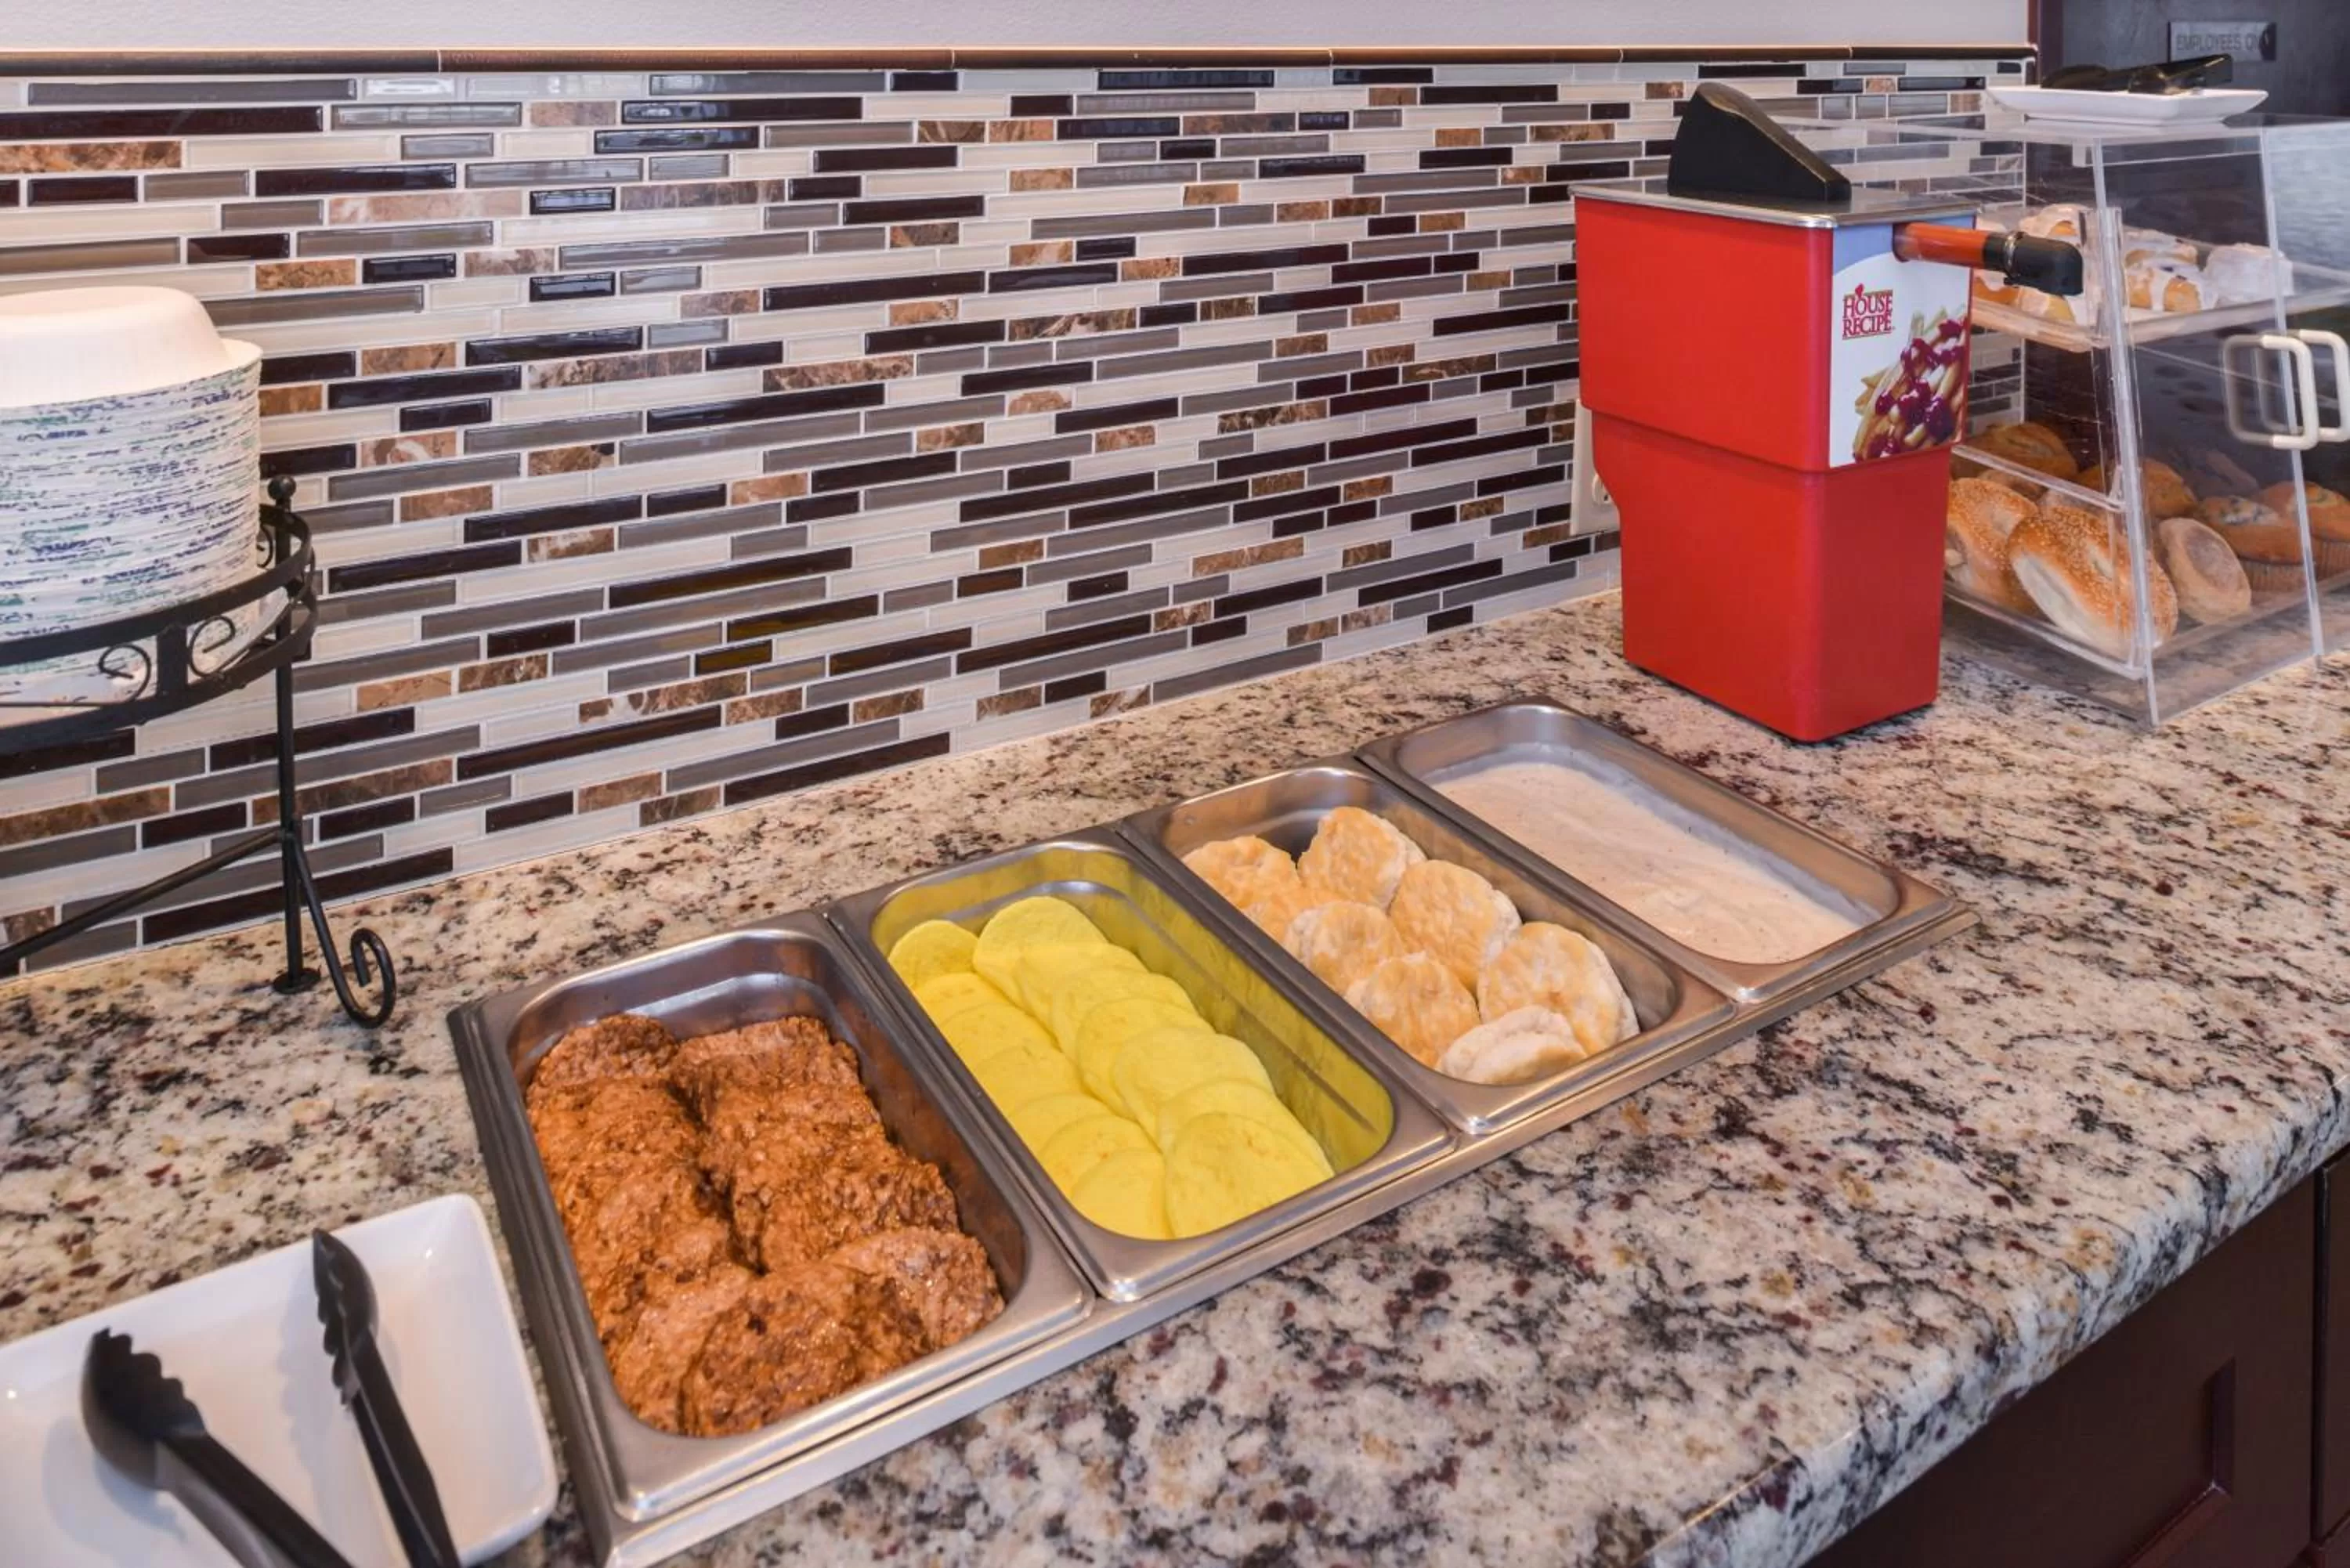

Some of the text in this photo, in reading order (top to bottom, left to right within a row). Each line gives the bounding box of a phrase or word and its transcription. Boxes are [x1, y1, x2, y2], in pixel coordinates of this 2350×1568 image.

[2176, 34, 2261, 51] EMPLOYEES ON
[1842, 291, 1893, 318] HOUSE
[1842, 313, 1892, 337] RECIPE
